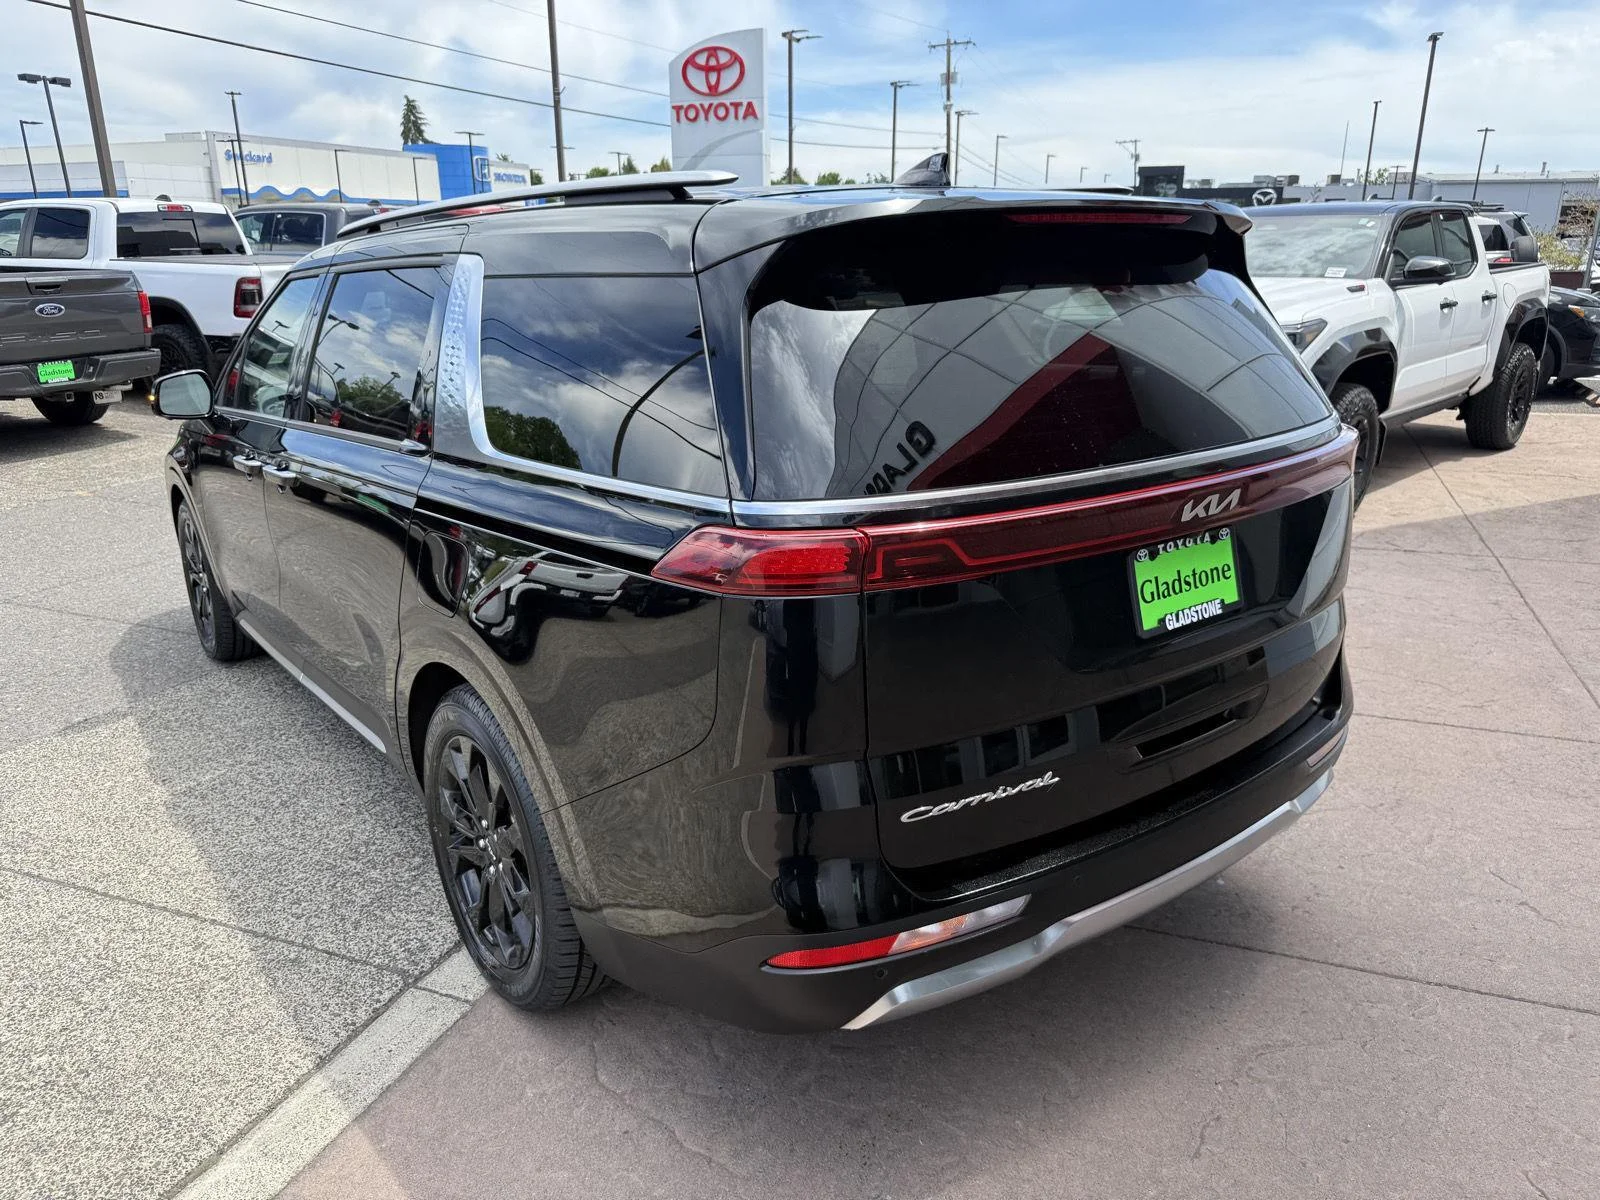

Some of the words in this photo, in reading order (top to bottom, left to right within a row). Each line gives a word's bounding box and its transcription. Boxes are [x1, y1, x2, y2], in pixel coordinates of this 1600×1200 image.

[672, 101, 759, 123] TOYOTA
[39, 368, 74, 378] Gladstone
[1157, 532, 1211, 555] TOYOTA
[1140, 563, 1232, 604] Gladstone
[1165, 599, 1223, 631] GLADSTONE
[901, 771, 1061, 823] Carnival
